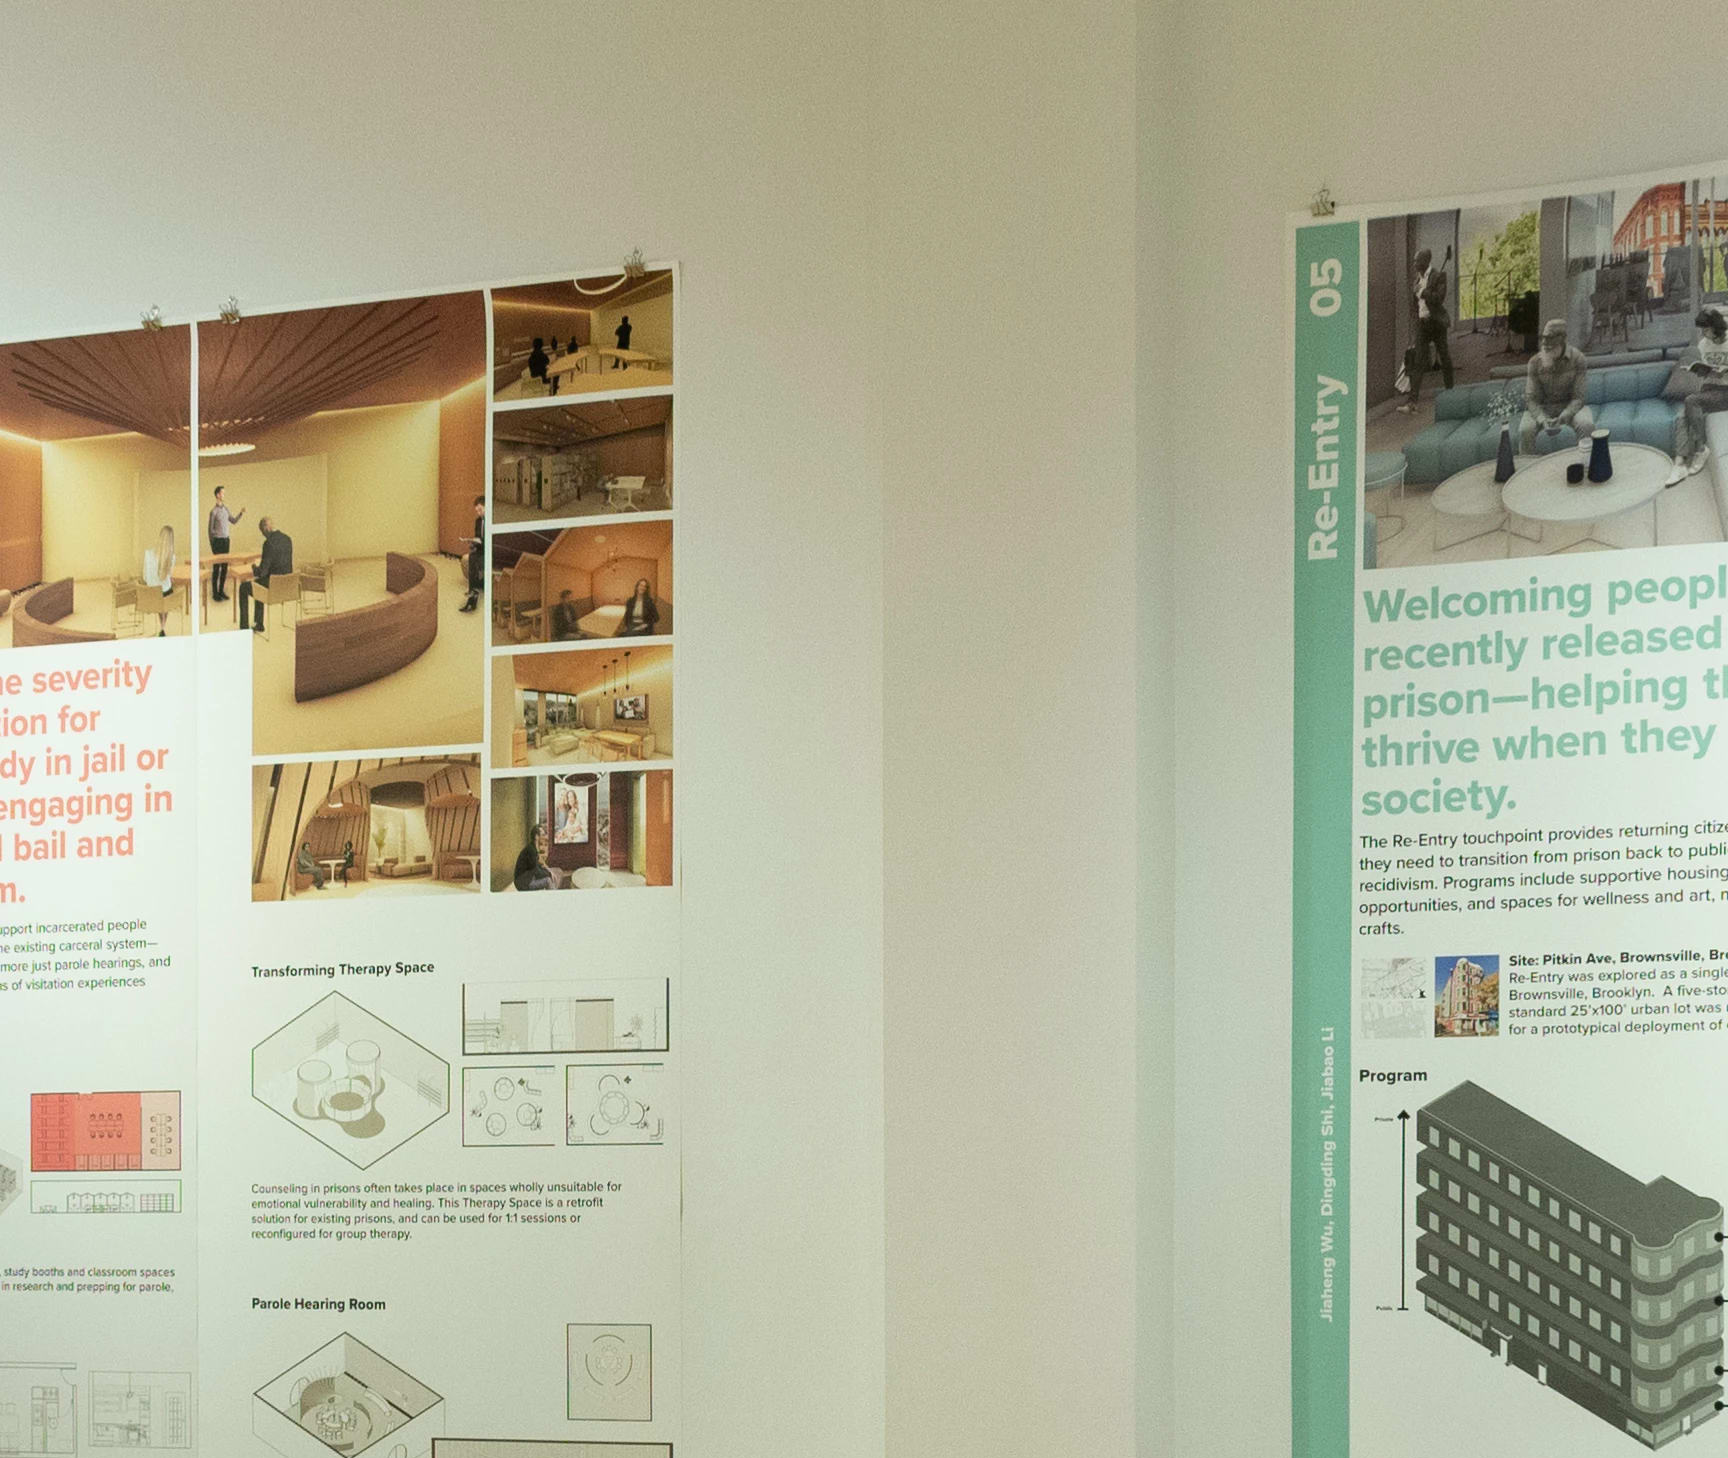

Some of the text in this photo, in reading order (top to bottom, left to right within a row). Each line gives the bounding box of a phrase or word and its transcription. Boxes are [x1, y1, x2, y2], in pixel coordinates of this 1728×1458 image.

[1308, 259, 1348, 560] Re-Entry 05
[1363, 577, 1591, 623] Welcoming
[1364, 630, 1528, 671] recently
[1543, 617, 1721, 660] released
[33, 660, 152, 695] severity
[58, 706, 101, 733] for
[1361, 731, 1480, 768] thrive
[1492, 726, 1606, 761] when
[1621, 719, 1717, 760] they
[46, 747, 71, 776] in
[78, 744, 125, 790] jail
[137, 749, 169, 771] or
[145, 783, 172, 813] in
[1362, 779, 1516, 819] society.
[14, 830, 66, 861] bail
[77, 827, 134, 858] and
[1360, 836, 1388, 848] The
[1393, 833, 1458, 848] Re-Entry
[1463, 829, 1543, 846] touchpoint
[1549, 826, 1613, 844] provides
[1619, 822, 1688, 838] returning
[252, 962, 434, 978] Transforming Therapy Space
[1509, 955, 1538, 966] Site:
[1543, 954, 1582, 965] Pitkin
[1586, 953, 1615, 964] Ave,
[1620, 950, 1704, 963] Brownsville,
[1360, 1070, 1427, 1085] Program
[252, 1228, 412, 1241] reconfigured for group therapy.
[252, 1298, 385, 1312] Parole Hearing Room
